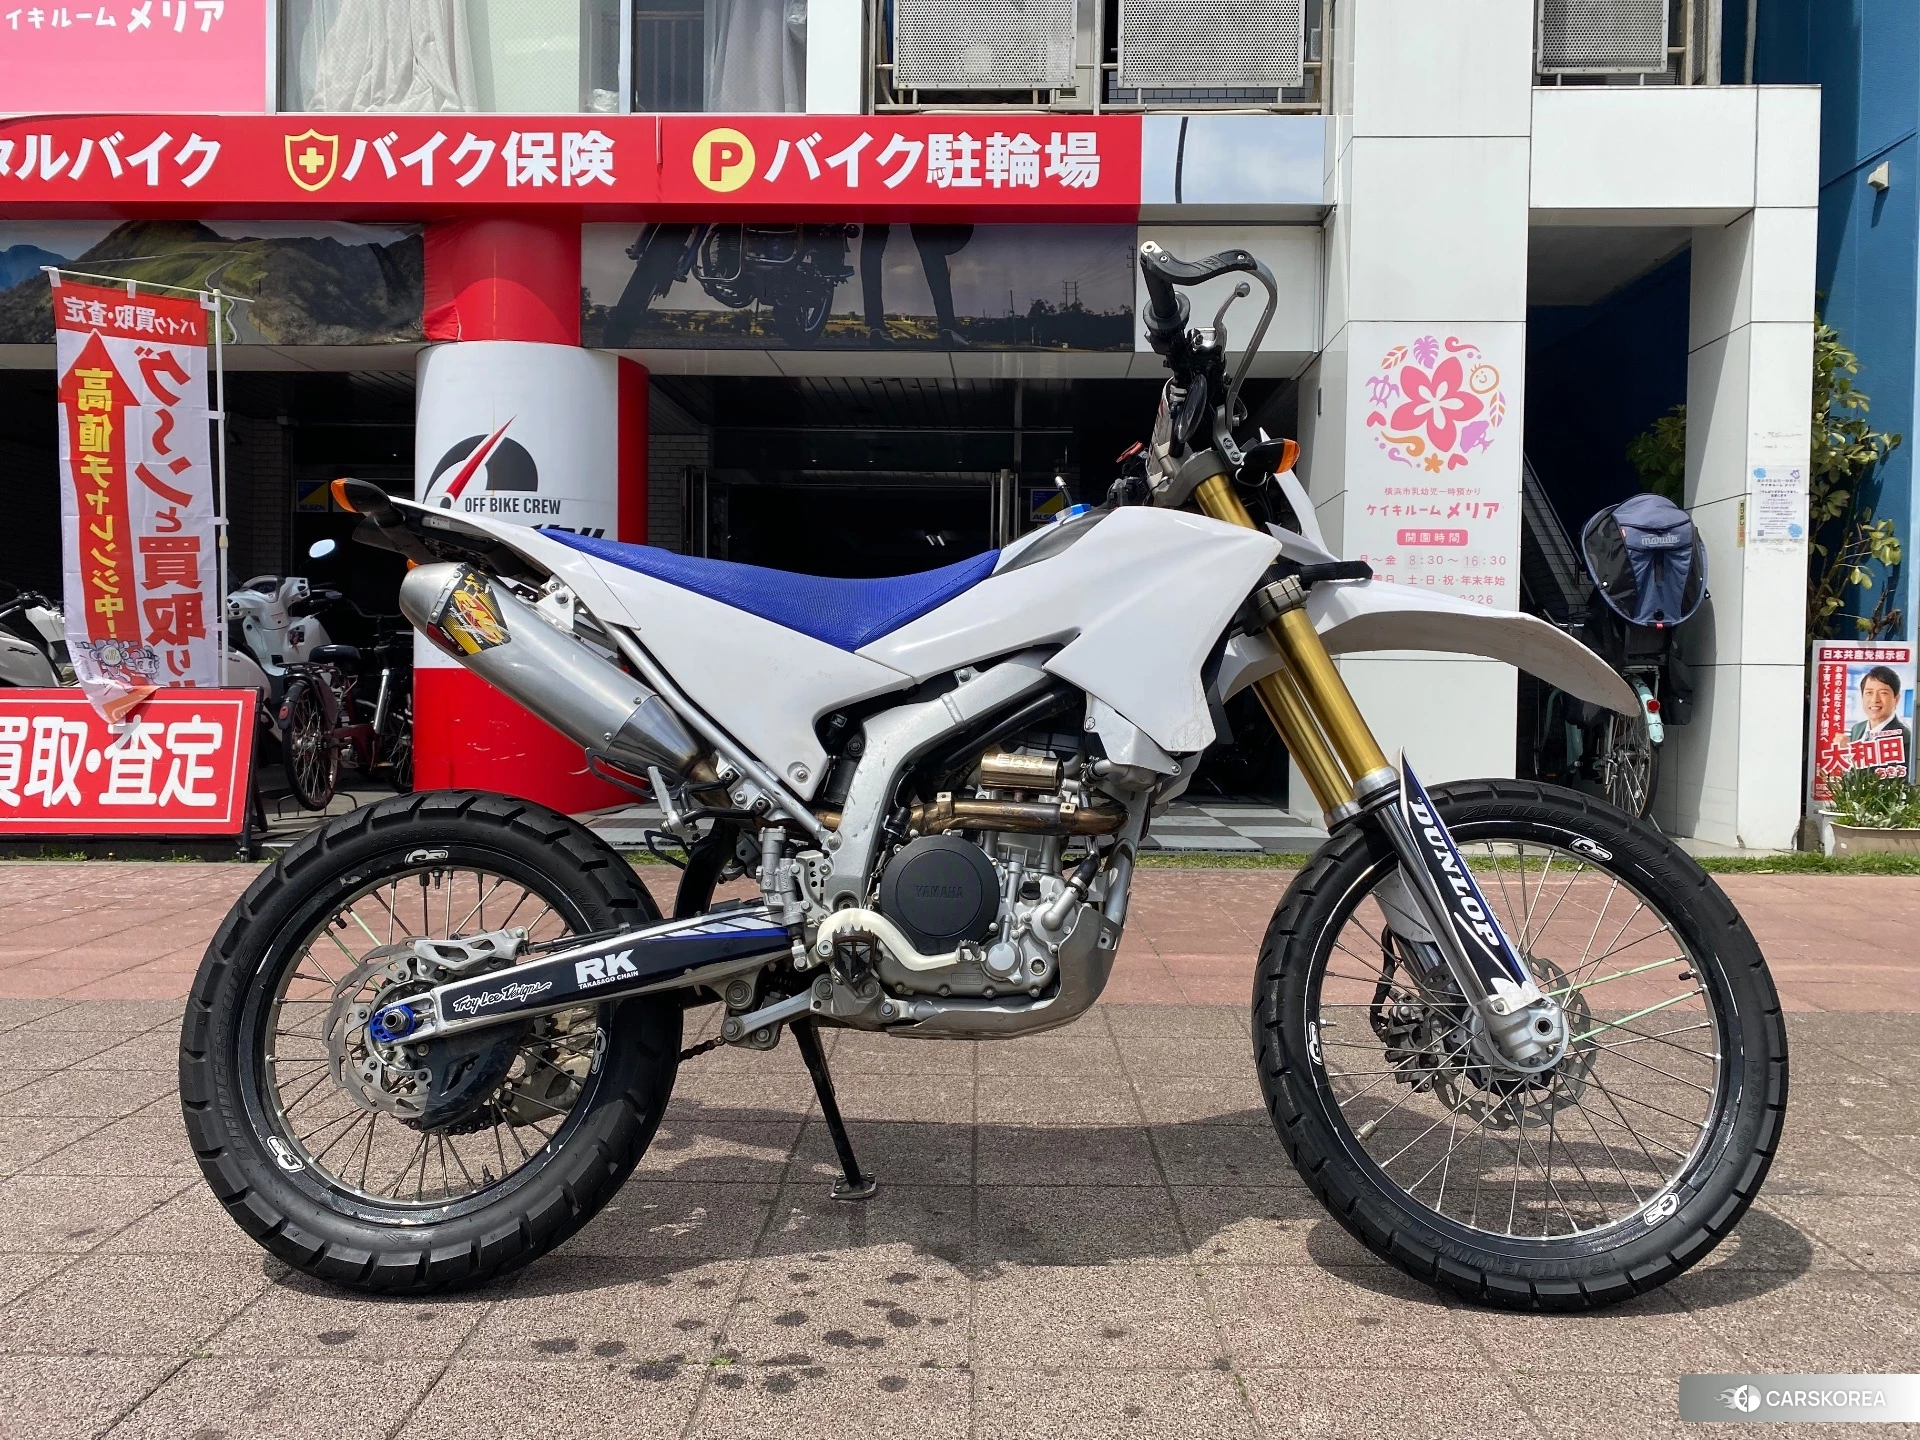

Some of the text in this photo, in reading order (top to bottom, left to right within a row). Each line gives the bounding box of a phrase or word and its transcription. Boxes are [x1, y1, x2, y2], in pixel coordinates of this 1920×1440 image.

[341, 129, 617, 188] バイク保険
[708, 140, 737, 182] P
[763, 130, 1101, 190] バイク駐輪場
[1384, 487, 1481, 496] 横浜市乳幼児一時預かり
[464, 497, 562, 515] OFF BIKE CREW
[1366, 502, 1500, 519] ケイキルーム メリア
[1405, 532, 1461, 544] 開園時間
[1823, 650, 1906, 661] 日本共産党掲示板
[1821, 736, 1906, 774] 大和田
[1408, 800, 1500, 947] DUNLOP
[915, 885, 964, 898] YAMAHA
[574, 948, 638, 984] RK
[578, 970, 639, 990] TAKASAGO CHAIN
